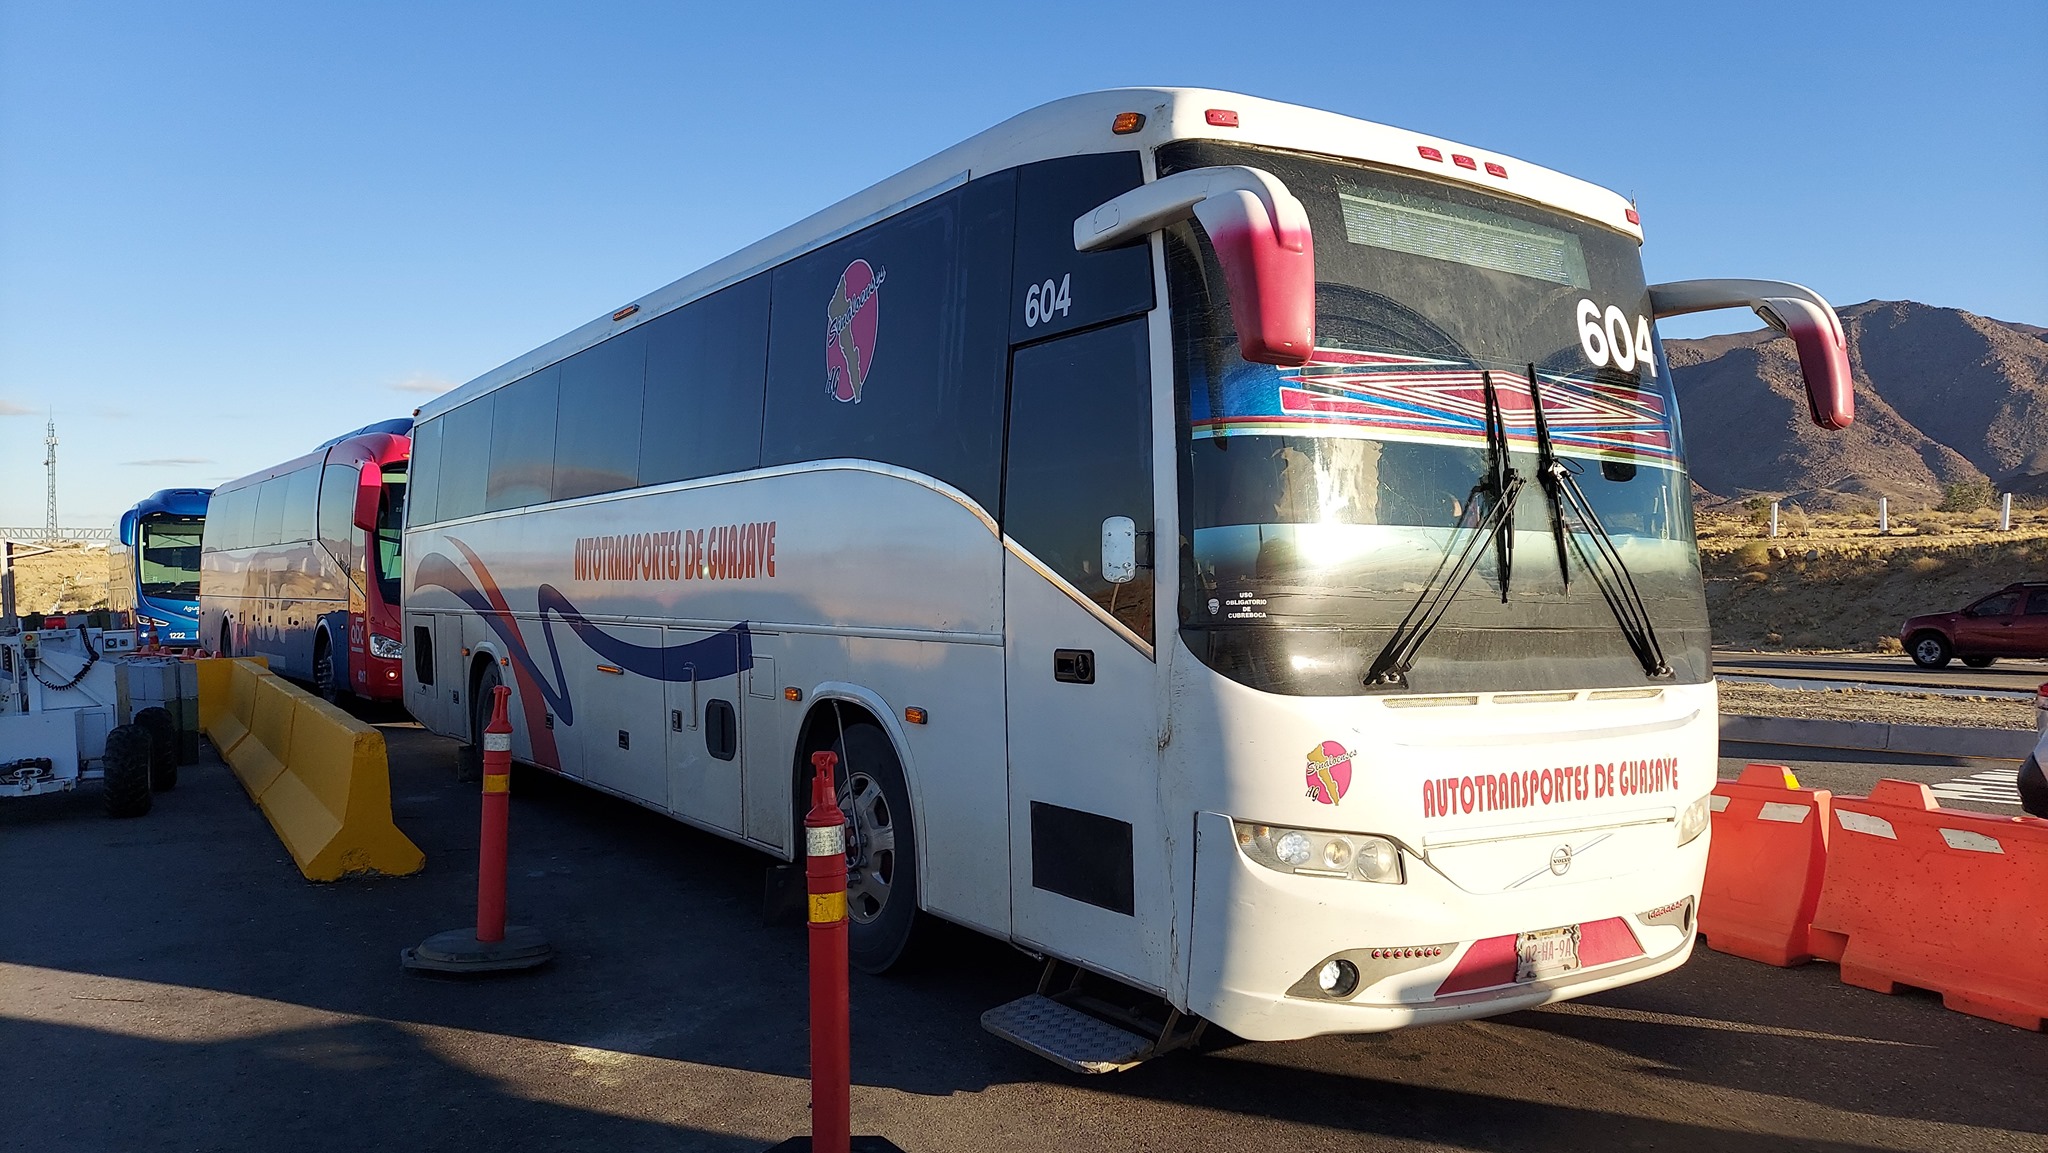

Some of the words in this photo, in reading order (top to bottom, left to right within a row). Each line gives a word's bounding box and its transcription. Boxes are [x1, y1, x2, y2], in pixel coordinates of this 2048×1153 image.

[1025, 273, 1071, 327] 604
[1577, 299, 1657, 377] 604
[575, 530, 681, 581] AUTOTRANSPORTES
[685, 529, 704, 580] DE
[708, 521, 776, 580] GUASAVE
[1423, 765, 1589, 818] AUTOTRANSPORTES
[1595, 763, 1614, 798] DE
[1619, 757, 1678, 796] GUASAVE
